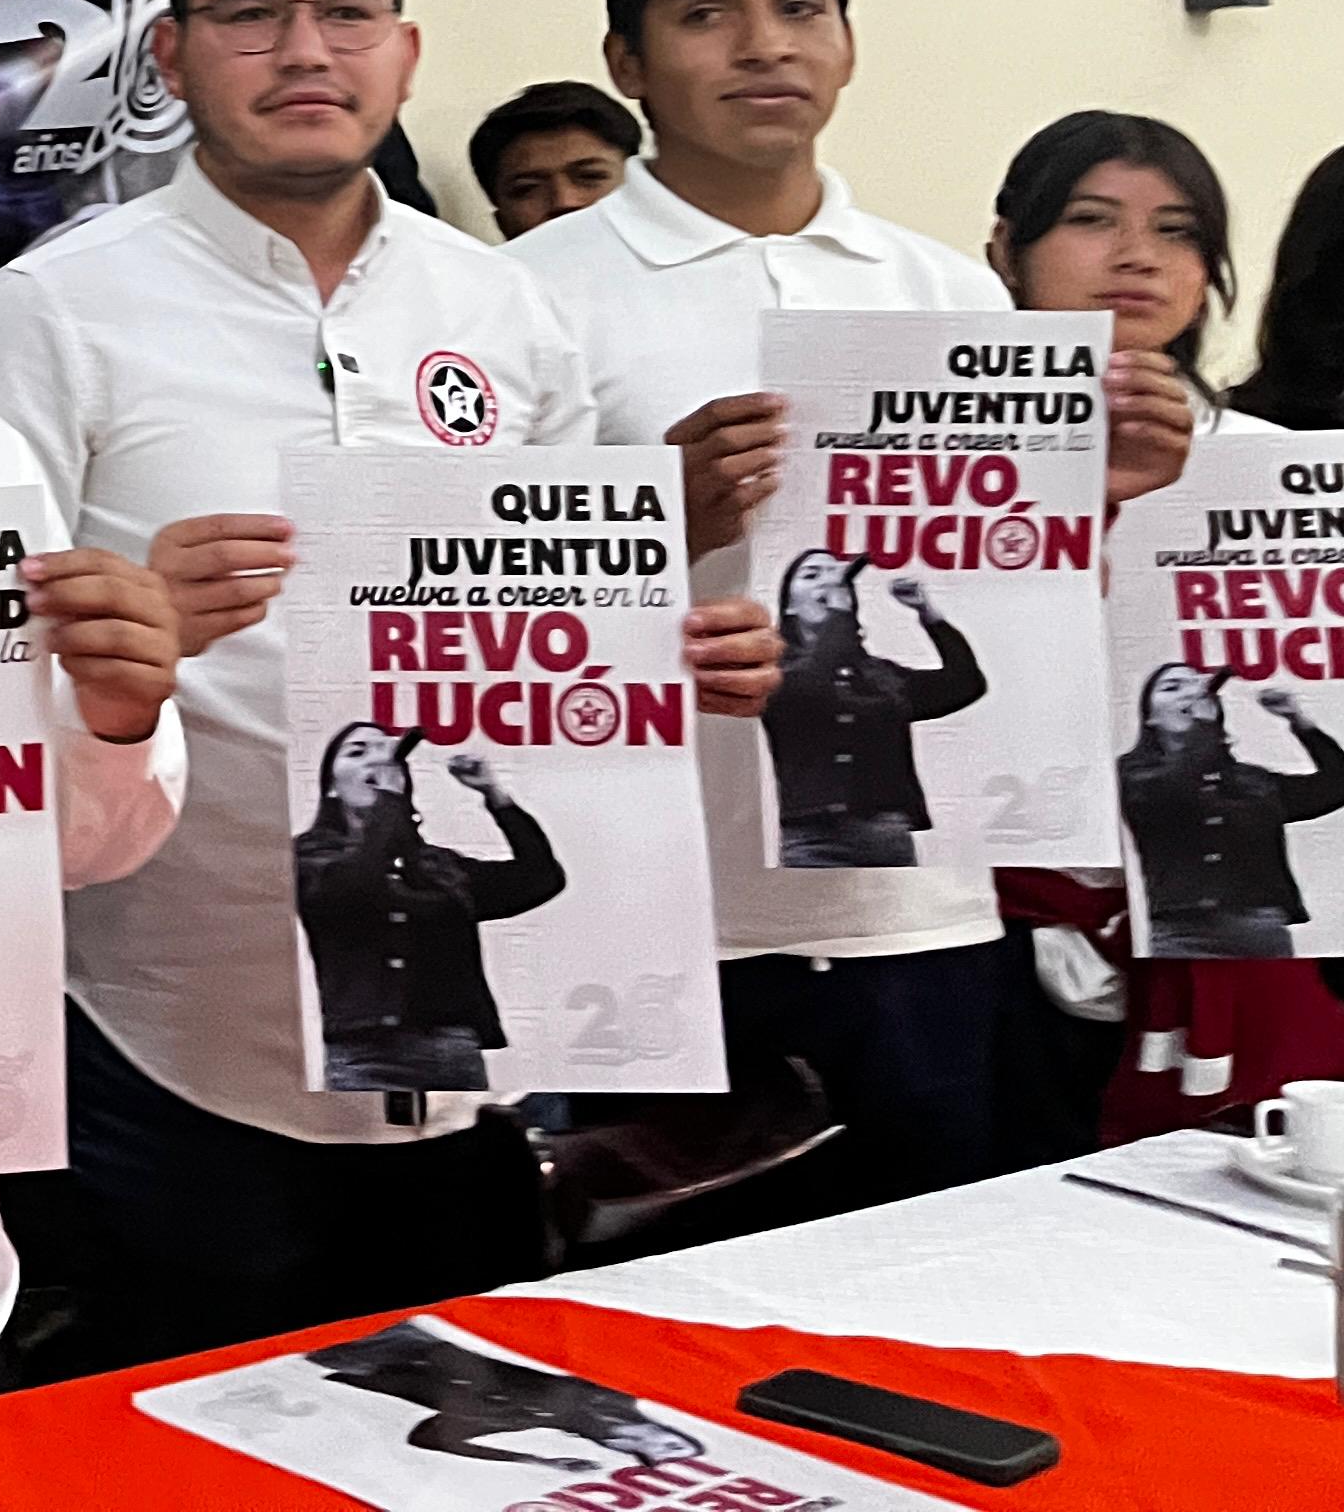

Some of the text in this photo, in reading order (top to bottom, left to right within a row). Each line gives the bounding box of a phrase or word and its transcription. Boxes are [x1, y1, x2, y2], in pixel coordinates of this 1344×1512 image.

[13, 133, 84, 174] años
[948, 344, 1096, 379] QUE LA
[868, 391, 1094, 433] JUVENTUD
[828, 453, 1019, 507] REVO
[491, 484, 666, 525] QUE LA
[826, 500, 1094, 571] LUCIÓN
[409, 537, 668, 590] JUVENTUD
[349, 576, 673, 608] vuelva a creer en la
[368, 610, 590, 673] REVO
[371, 665, 686, 747] LUCIÓN
